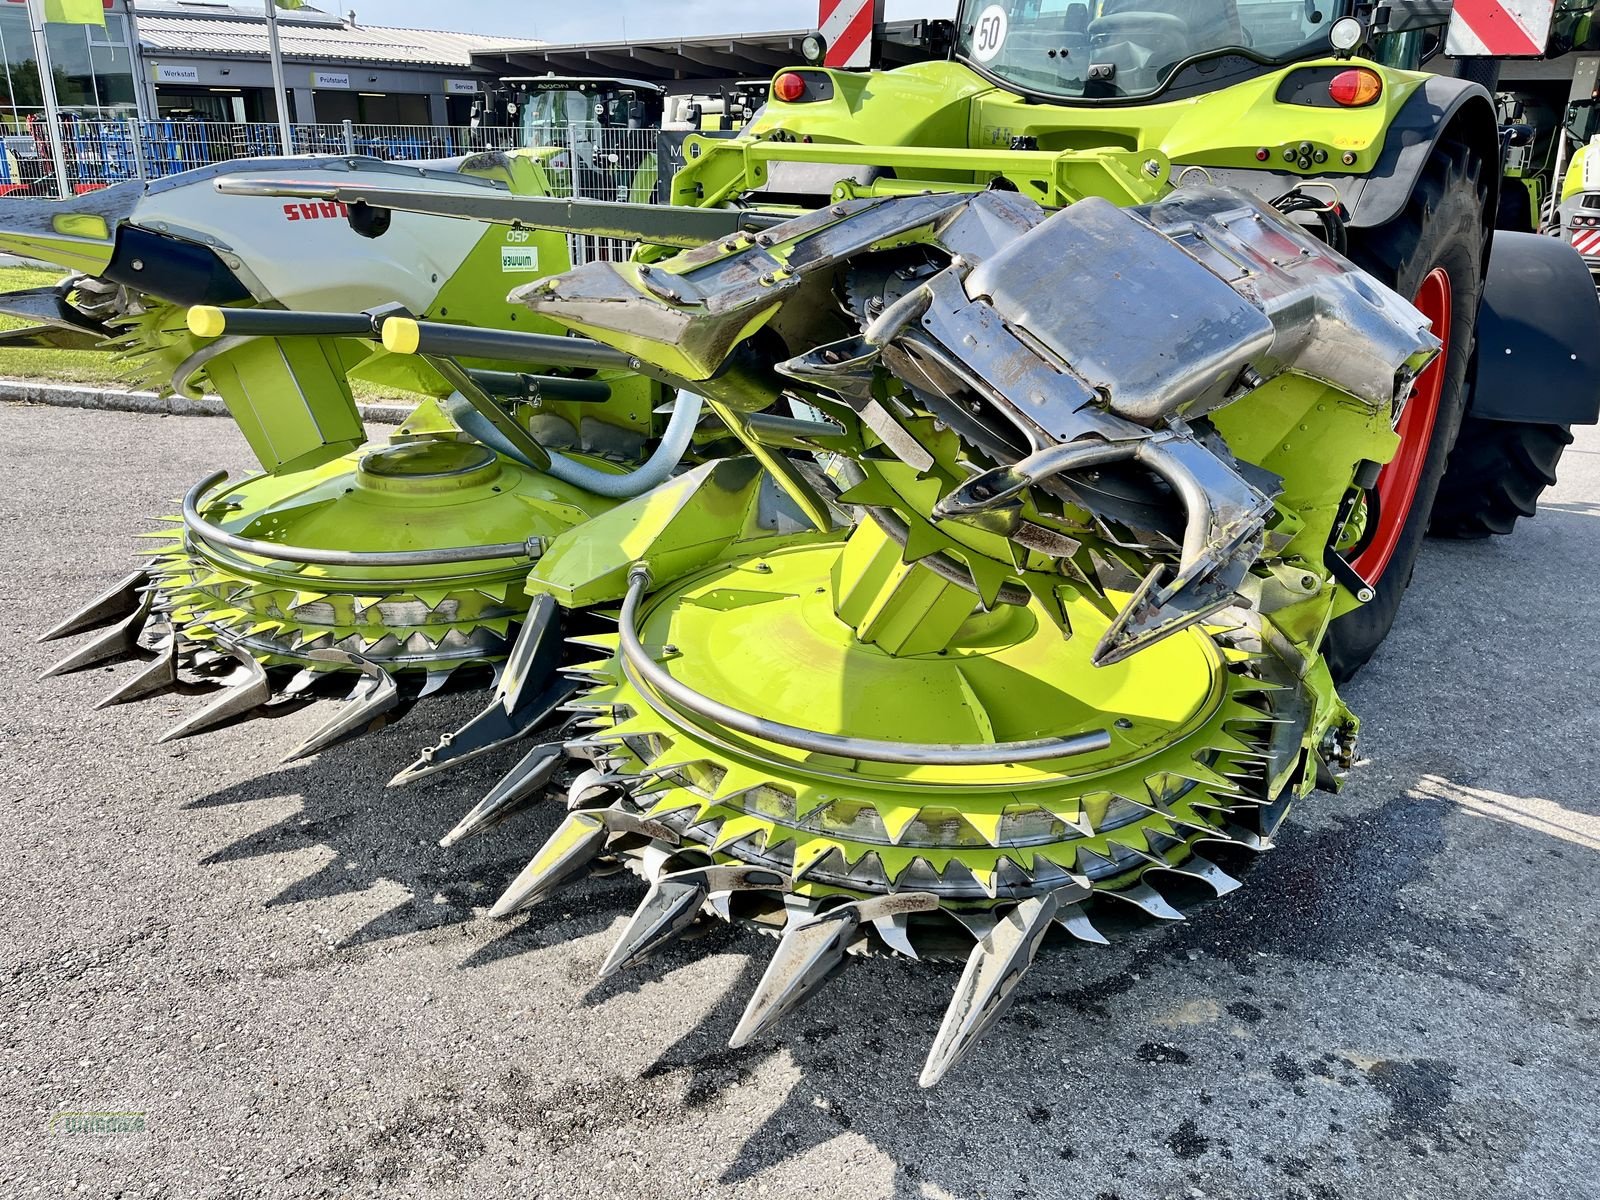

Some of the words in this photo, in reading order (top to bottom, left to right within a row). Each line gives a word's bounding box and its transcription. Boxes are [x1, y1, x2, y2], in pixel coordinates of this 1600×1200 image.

[979, 16, 1000, 50] 50
[164, 70, 195, 78] Werkstatt
[320, 76, 348, 84] Prüfstand
[283, 202, 348, 221] LAAS
[507, 231, 529, 242] 450
[503, 255, 531, 266] WIMMER
